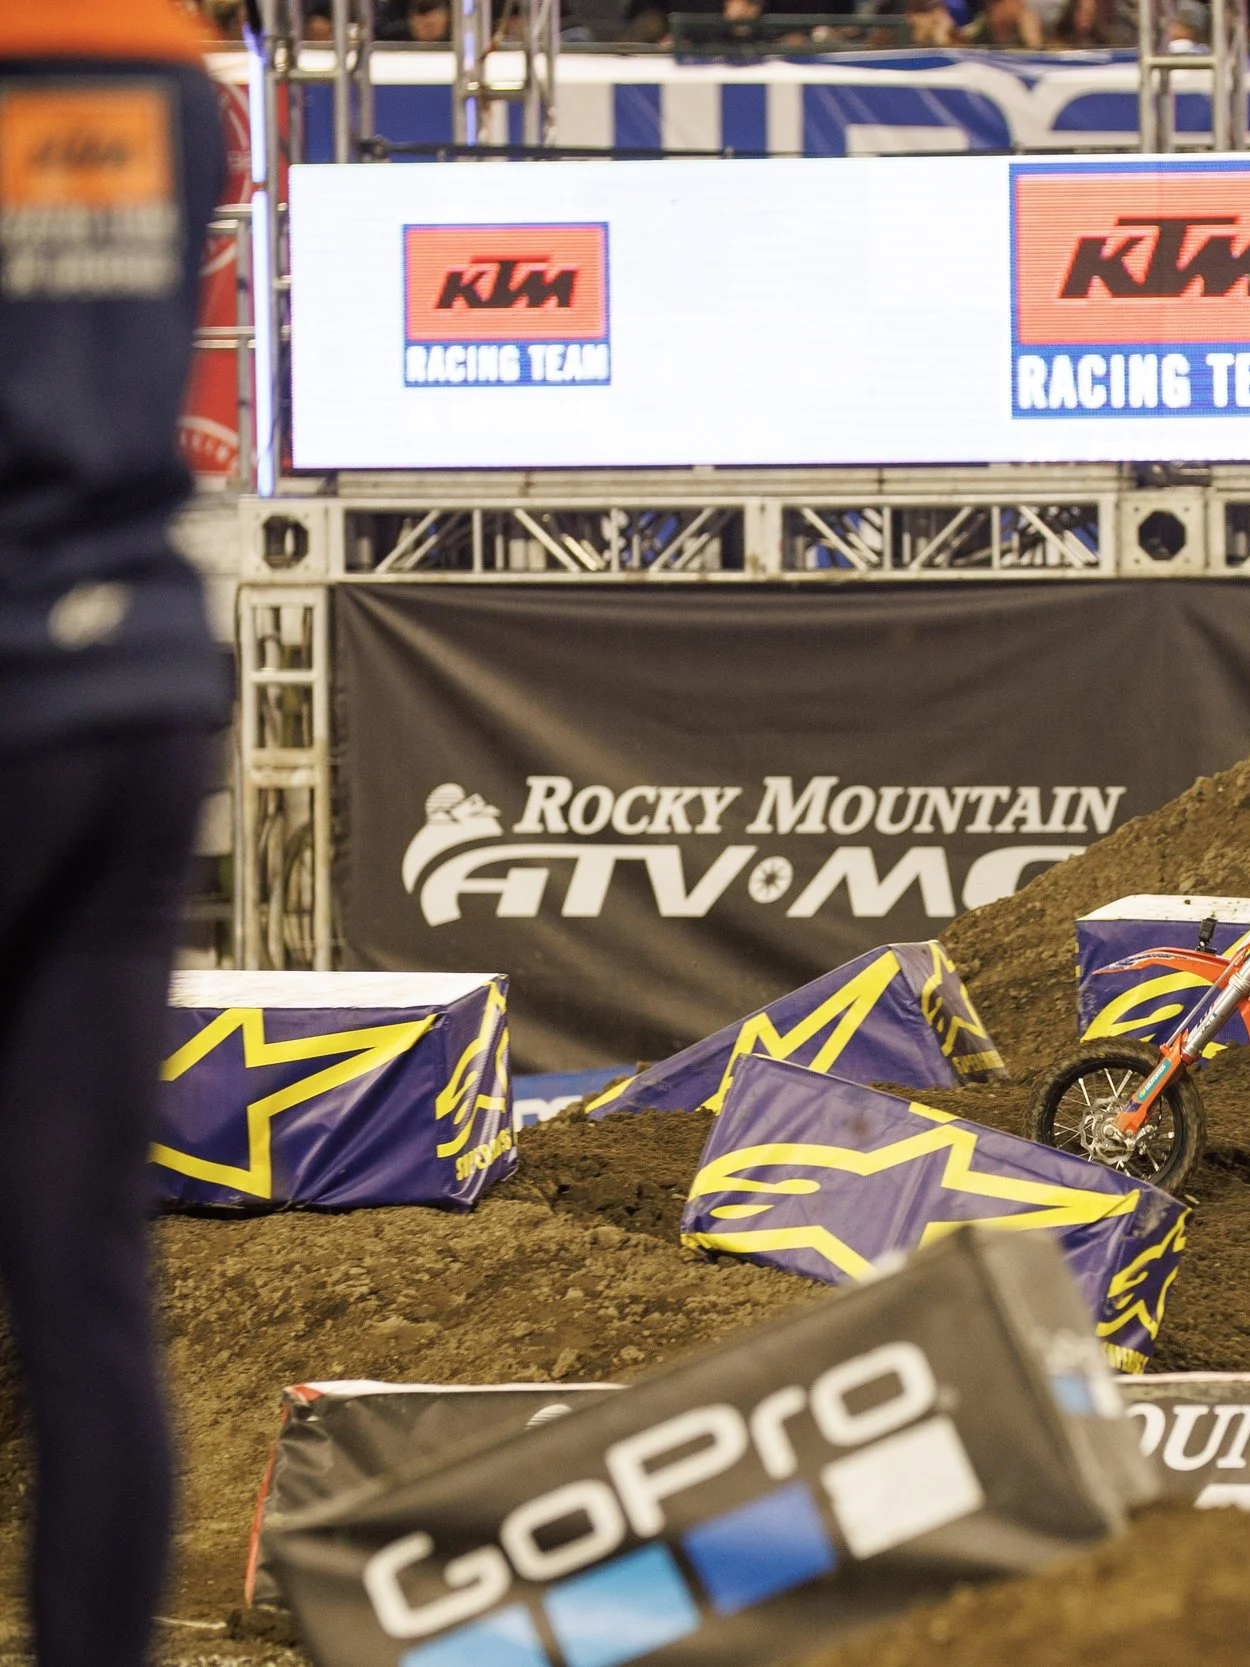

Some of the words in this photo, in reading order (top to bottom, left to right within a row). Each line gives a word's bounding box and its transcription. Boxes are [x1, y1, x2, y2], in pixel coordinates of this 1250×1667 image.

[435, 255, 578, 308] KTM
[405, 345, 520, 381] RACING
[528, 344, 609, 380] TEAM
[1017, 354, 1191, 409] RACING
[512, 776, 743, 834] ROCKY
[746, 776, 1127, 834] MOUNTAIN
[364, 1341, 937, 1638] GoPro
